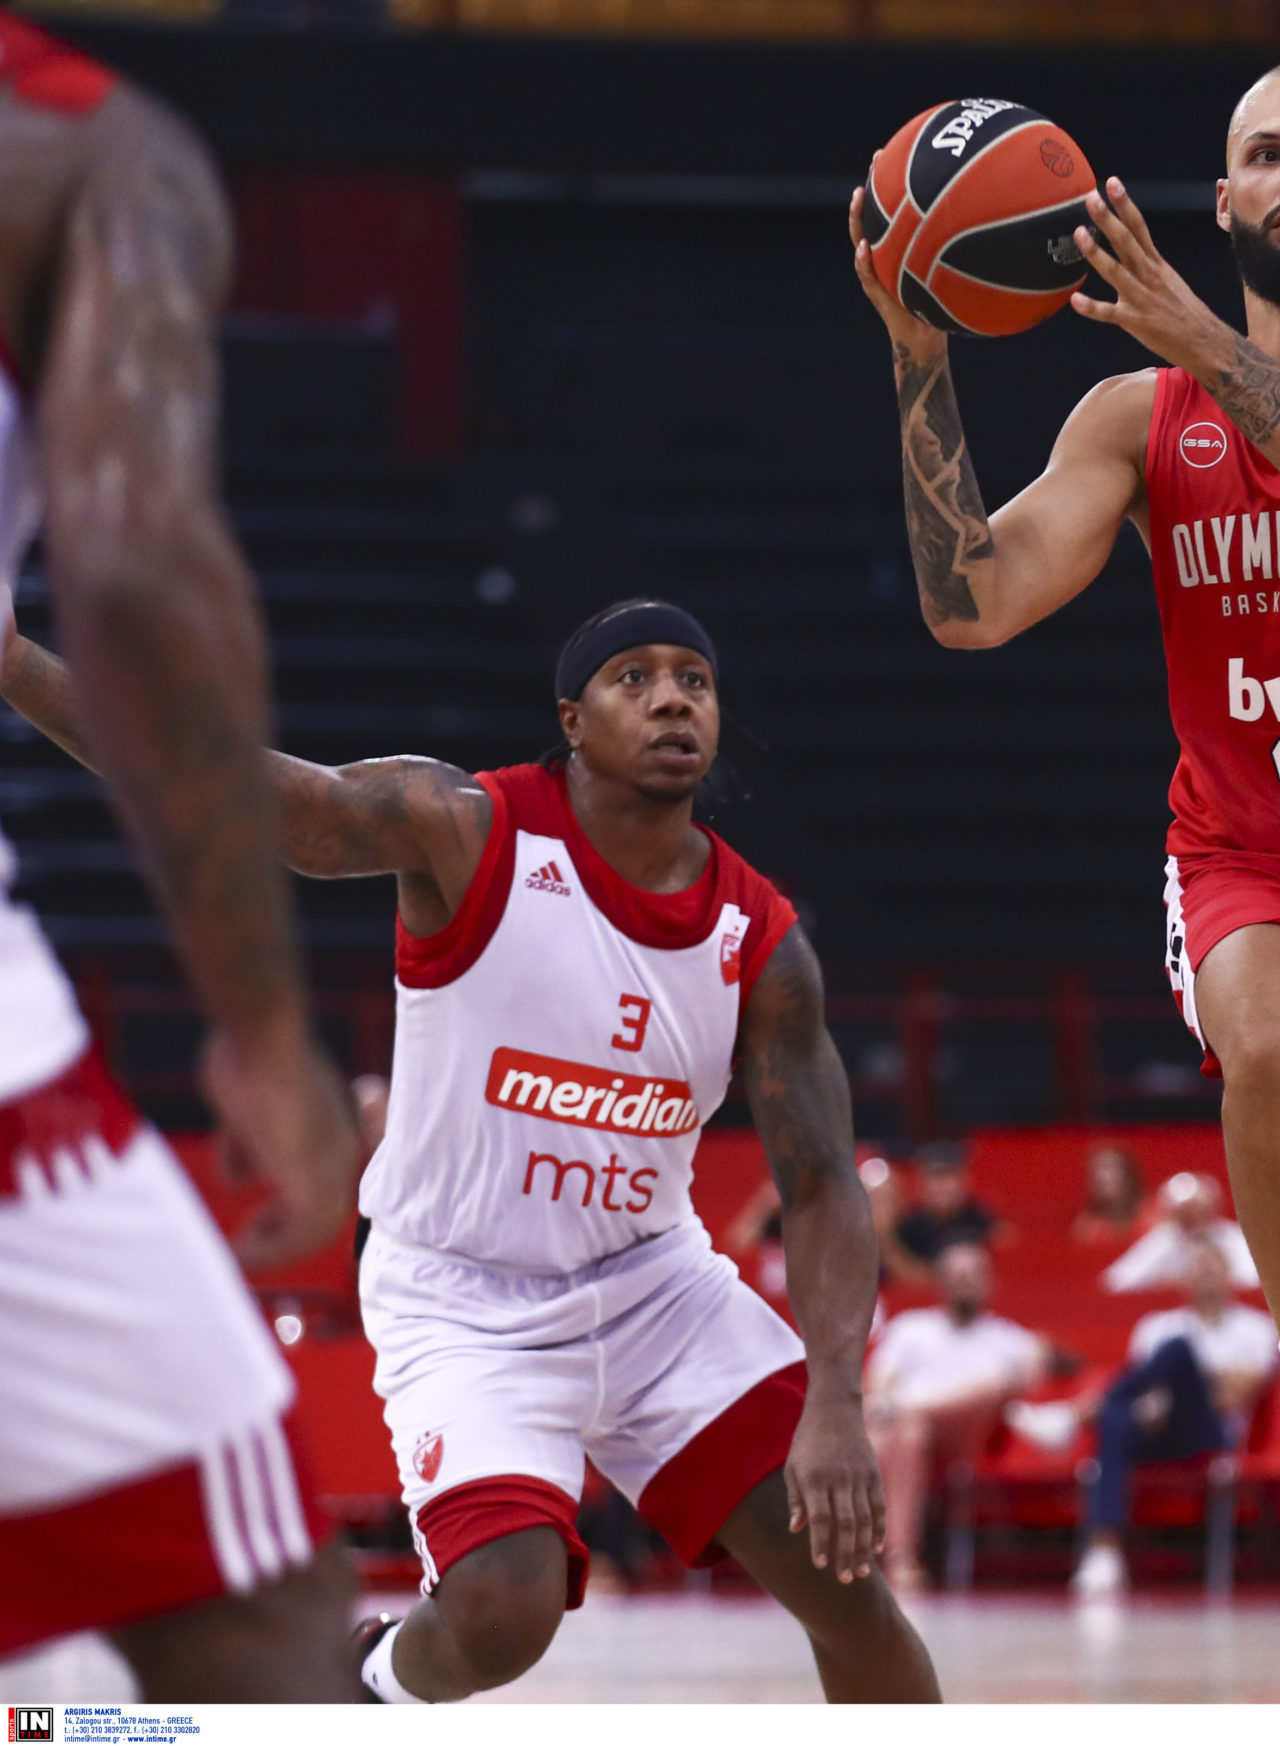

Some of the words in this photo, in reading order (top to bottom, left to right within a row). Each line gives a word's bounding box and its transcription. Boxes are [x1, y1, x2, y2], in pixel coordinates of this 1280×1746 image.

[1183, 438, 1223, 449] GSA
[525, 878, 571, 897] adidas
[611, 993, 652, 1053] 3
[522, 1151, 659, 1213] mts
